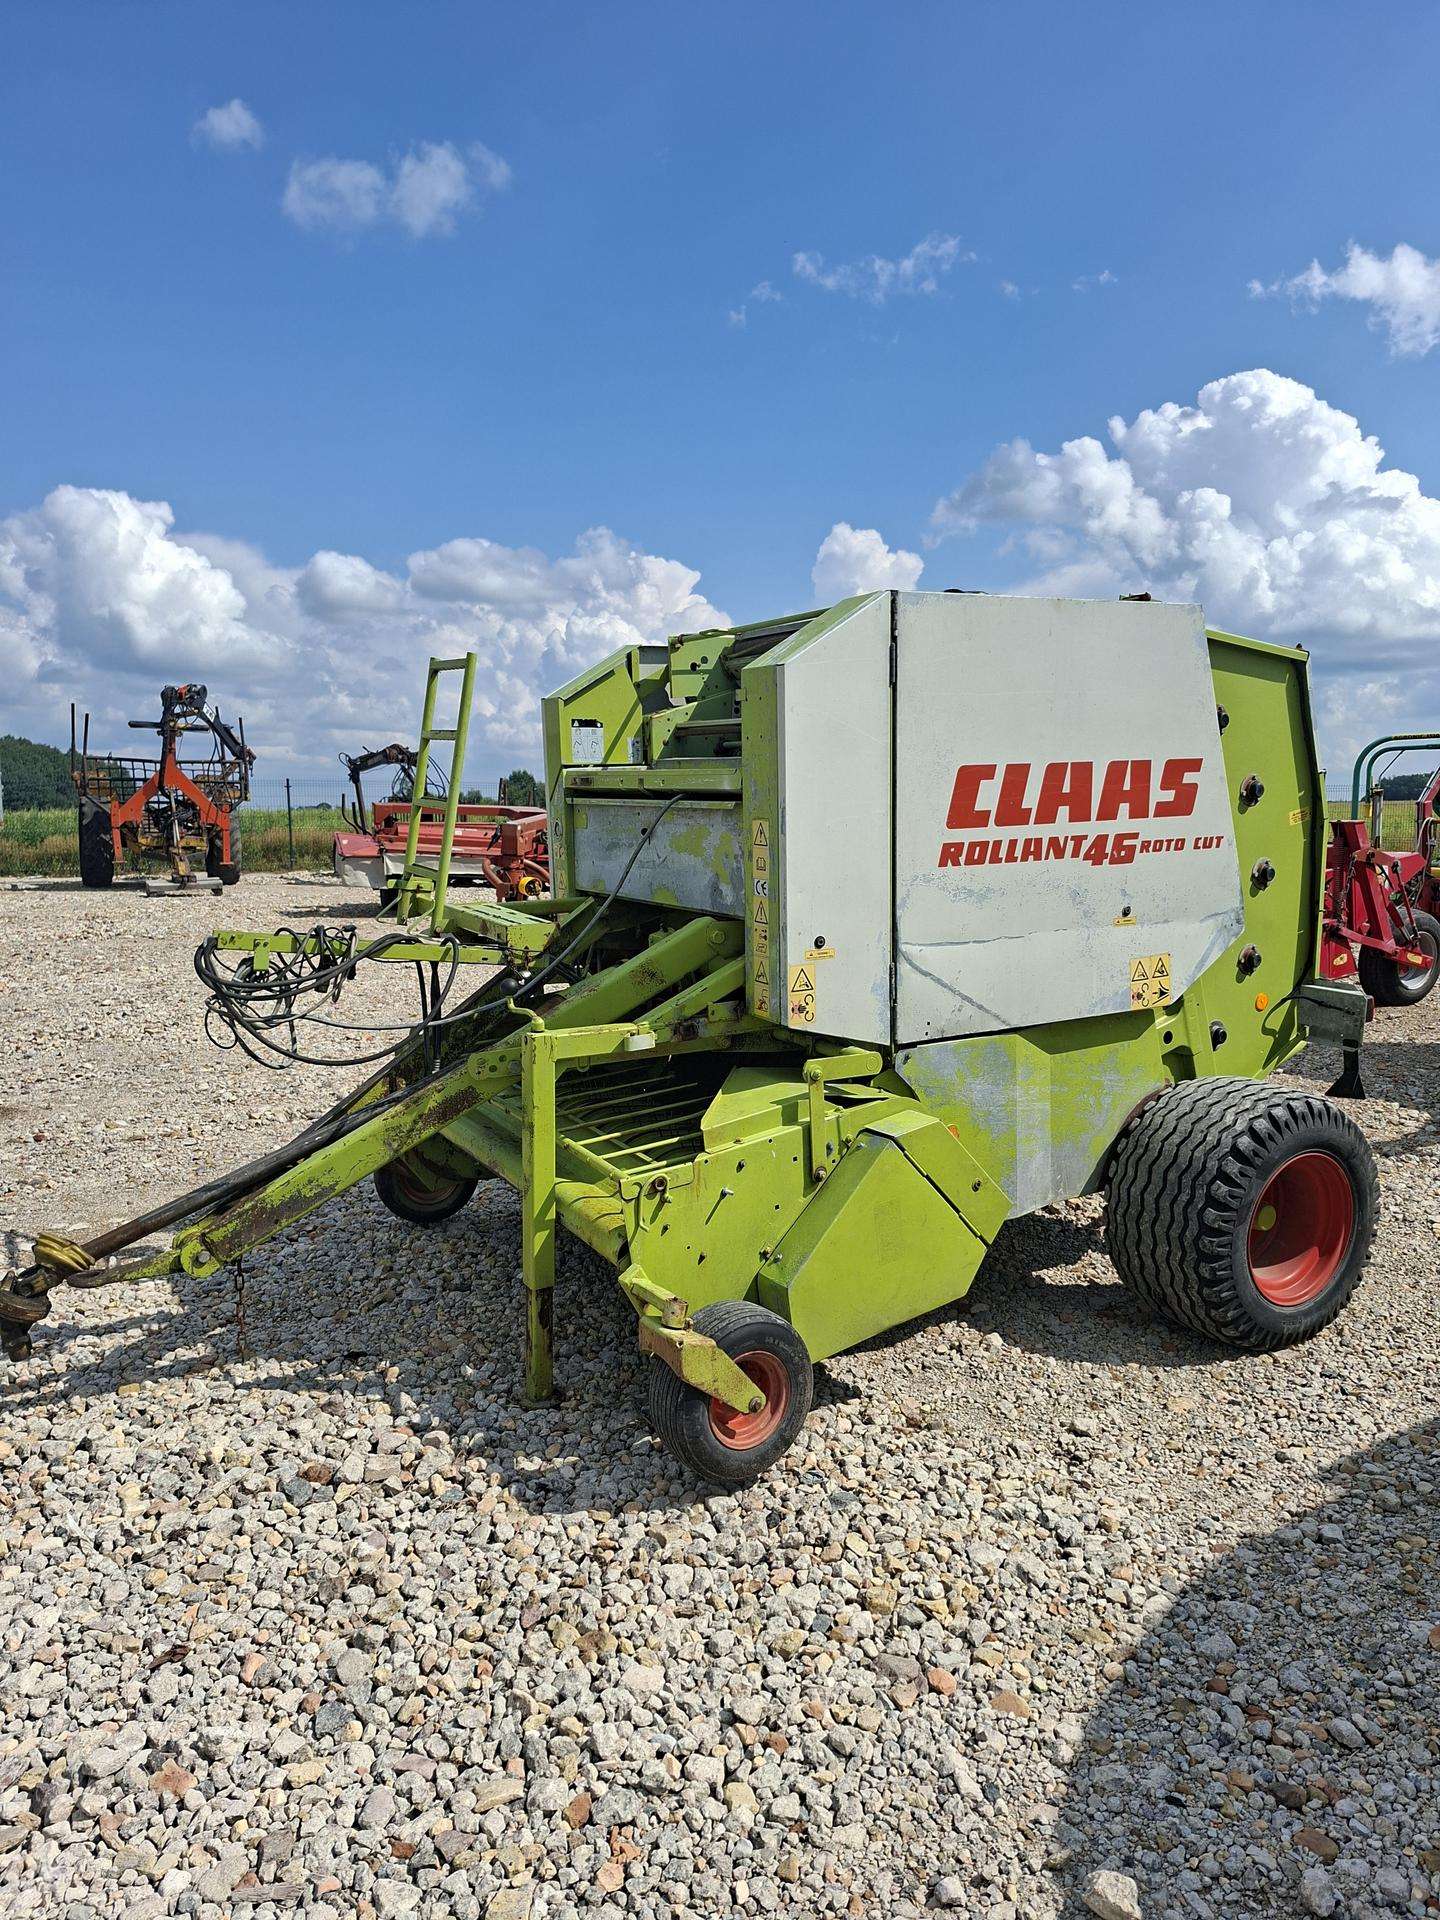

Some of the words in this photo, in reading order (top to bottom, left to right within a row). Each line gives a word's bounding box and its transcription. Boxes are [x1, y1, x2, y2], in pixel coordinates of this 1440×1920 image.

[946, 758, 1204, 829] CLAAS
[1139, 838, 1186, 854] ROTO
[1193, 835, 1225, 850] CUT
